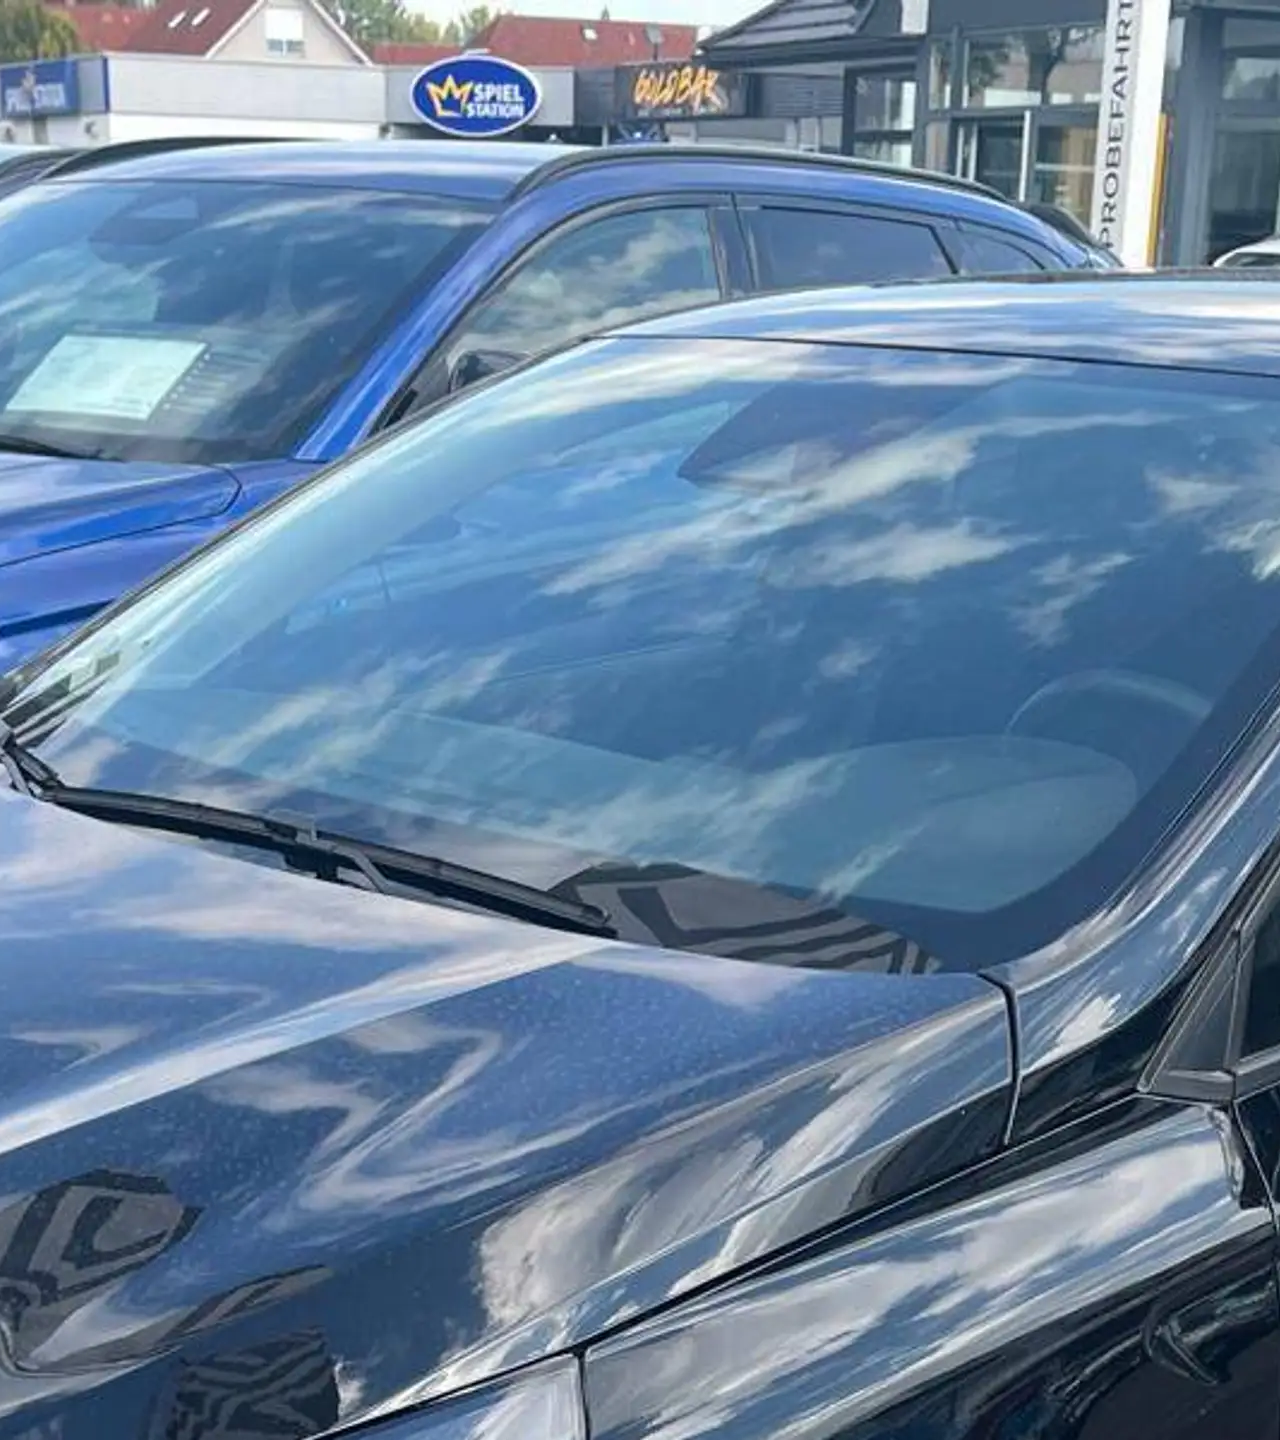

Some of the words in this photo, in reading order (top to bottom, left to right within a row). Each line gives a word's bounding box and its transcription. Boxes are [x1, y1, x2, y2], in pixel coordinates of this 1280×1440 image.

[474, 83, 525, 102] SPIEL
[467, 102, 526, 118] STATION
[1098, 0, 1134, 249] PROBEFAHRT
